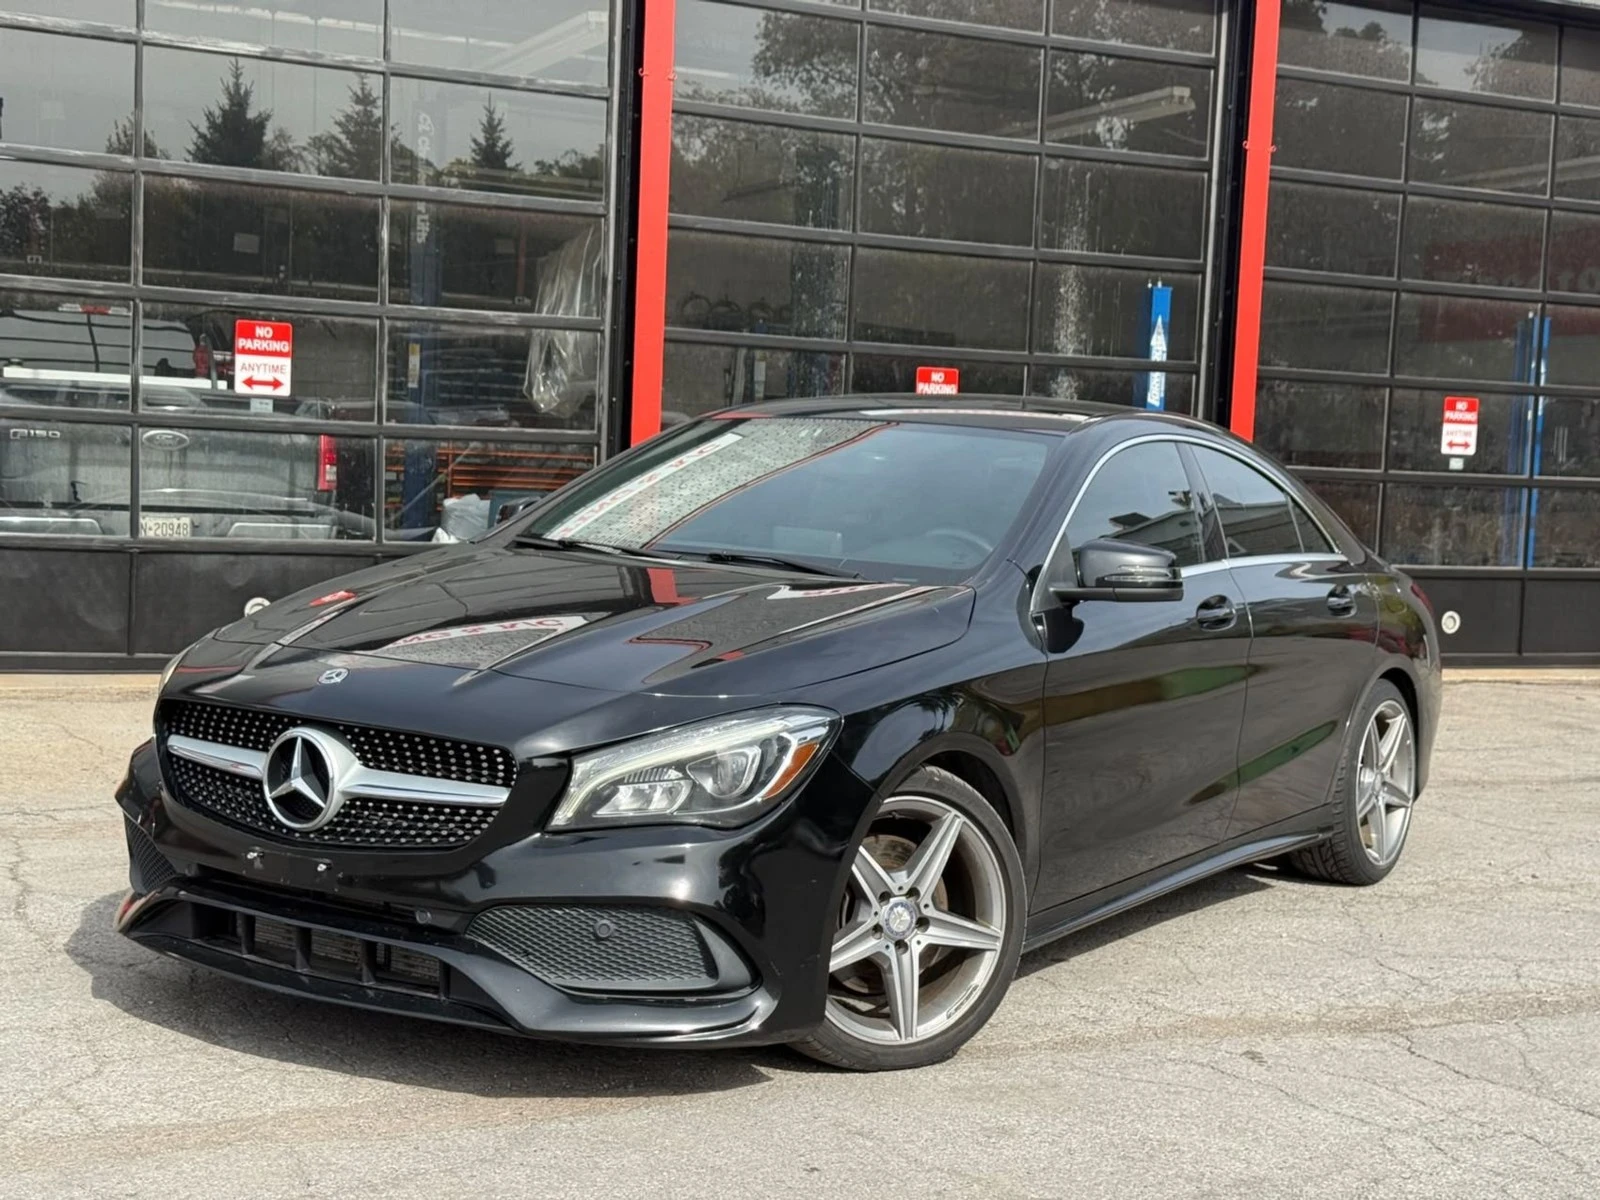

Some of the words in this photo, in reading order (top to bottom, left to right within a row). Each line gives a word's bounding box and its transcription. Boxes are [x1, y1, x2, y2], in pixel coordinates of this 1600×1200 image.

[255, 325, 273, 339] NO
[237, 337, 289, 353] PARKING
[240, 362, 287, 374] ANYTIME
[931, 371, 945, 383] NO
[917, 382, 957, 395] PARKING
[1455, 401, 1468, 411] NO
[1444, 409, 1477, 421] PARKING
